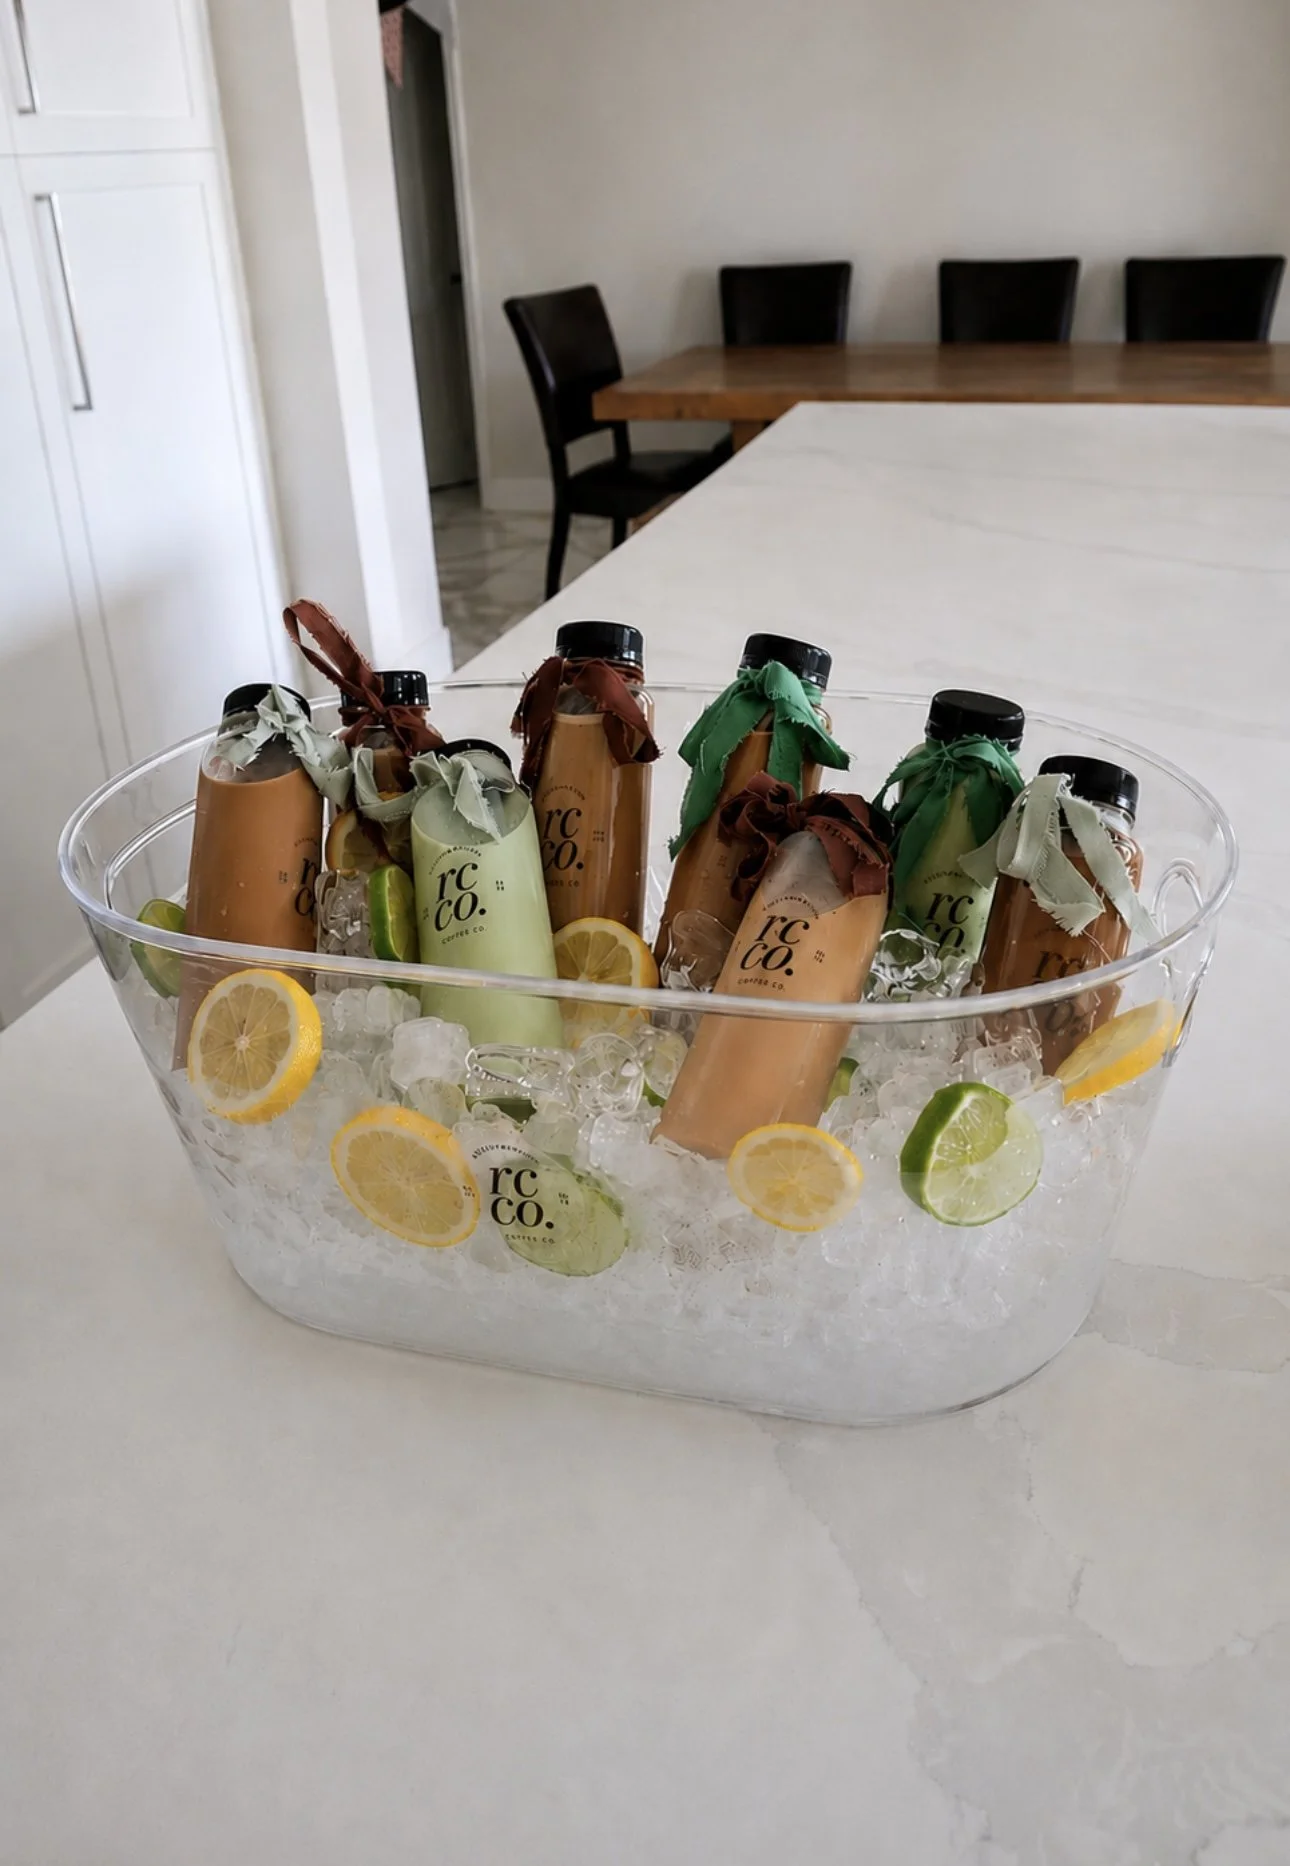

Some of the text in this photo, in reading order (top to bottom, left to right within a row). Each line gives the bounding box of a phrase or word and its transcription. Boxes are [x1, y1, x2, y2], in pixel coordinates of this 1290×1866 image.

[544, 807, 582, 839] rc
[437, 862, 478, 904] rc
[434, 891, 486, 932] co.
[924, 893, 974, 925] rc
[755, 915, 810, 945] rc
[740, 942, 793, 976] co.
[489, 1167, 538, 1198] rc
[490, 1196, 554, 1229] co.
